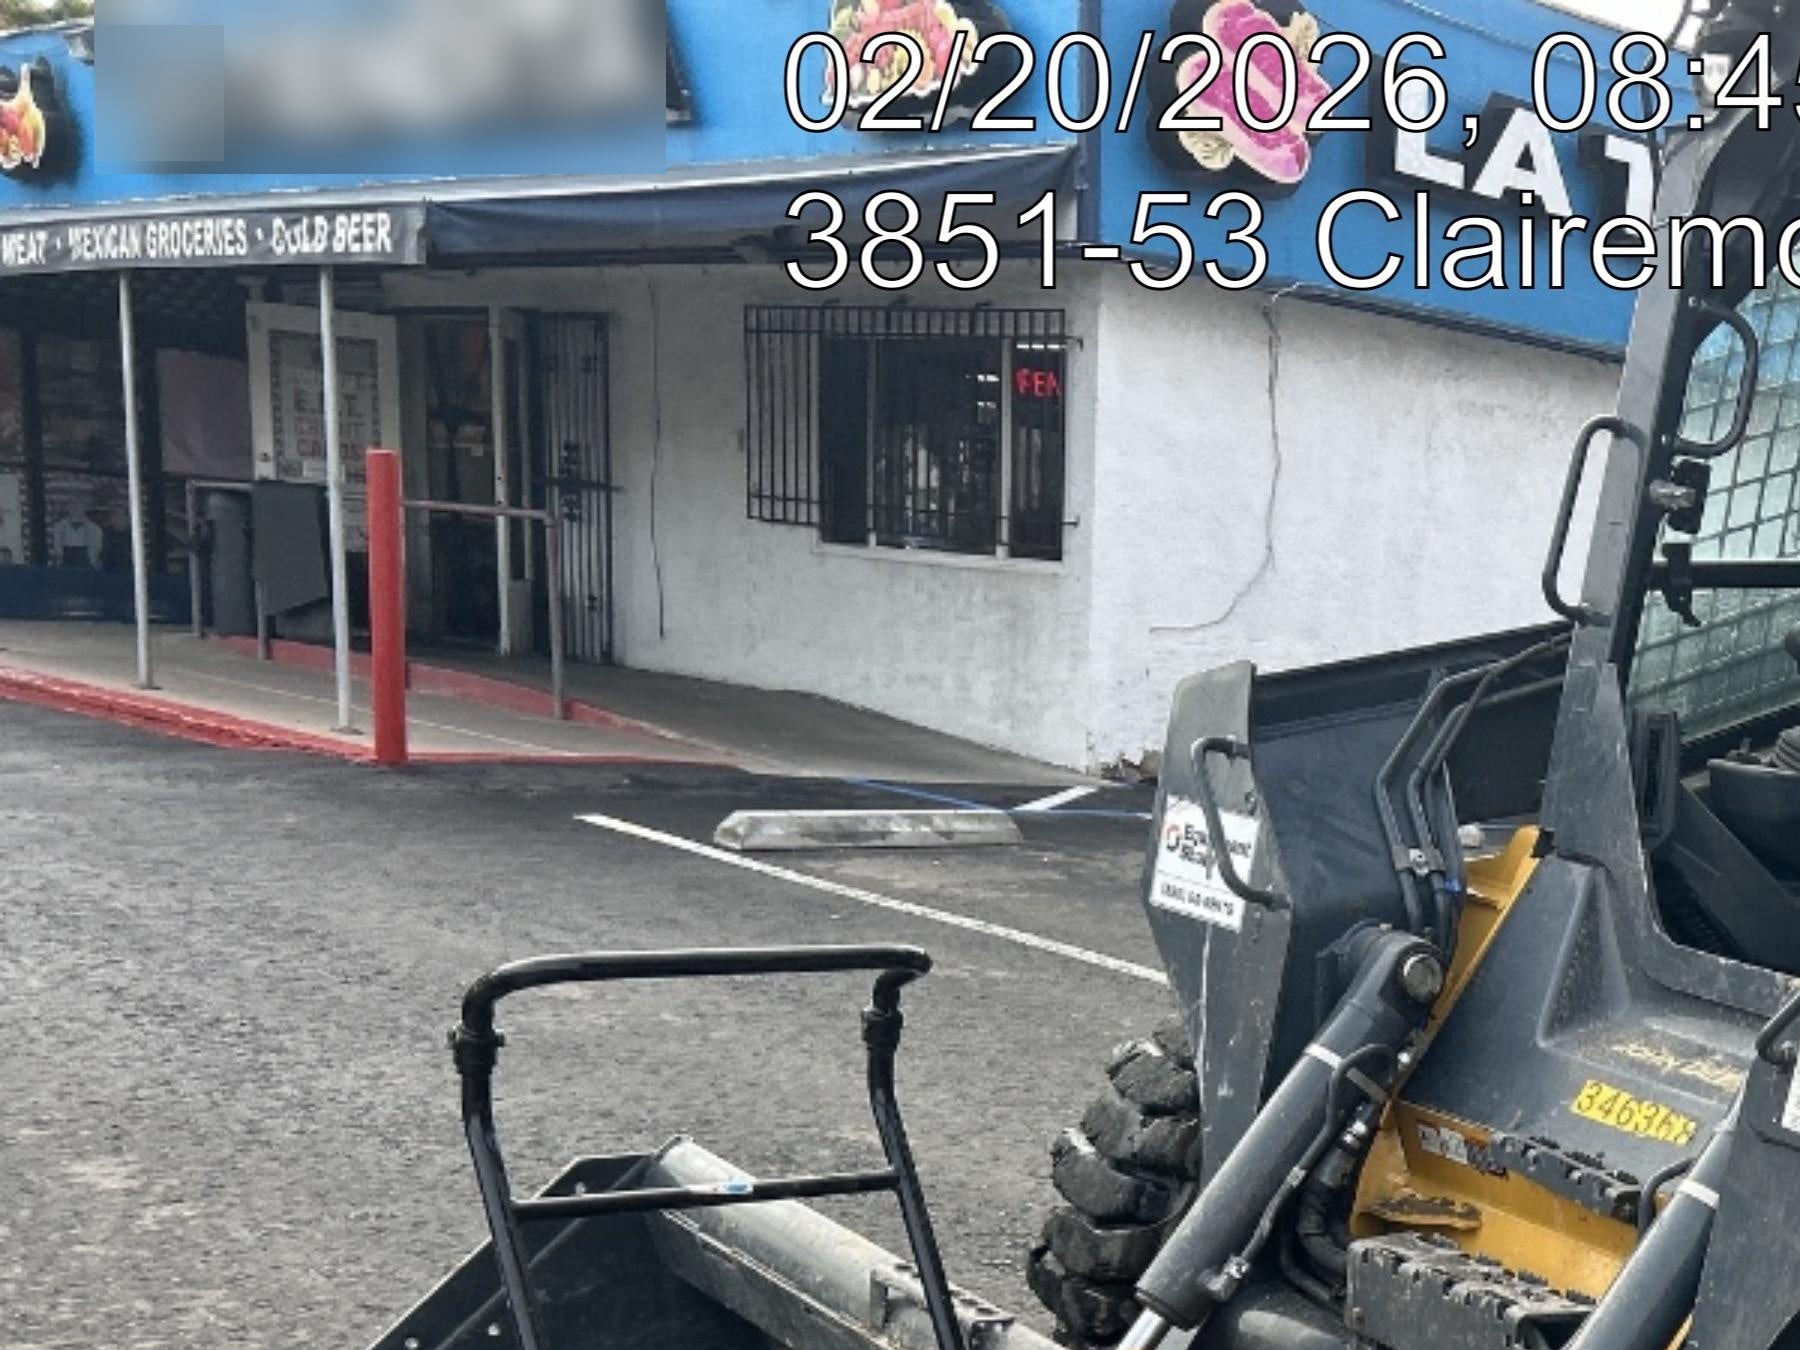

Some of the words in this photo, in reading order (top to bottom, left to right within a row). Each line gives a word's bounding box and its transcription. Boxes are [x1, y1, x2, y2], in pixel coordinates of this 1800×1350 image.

[68, 223, 143, 262] MEXICAN
[146, 217, 249, 259] GROCERIES
[271, 214, 328, 256] COLD
[333, 211, 394, 254] BEER
[1577, 1080, 1697, 1144] 346368
